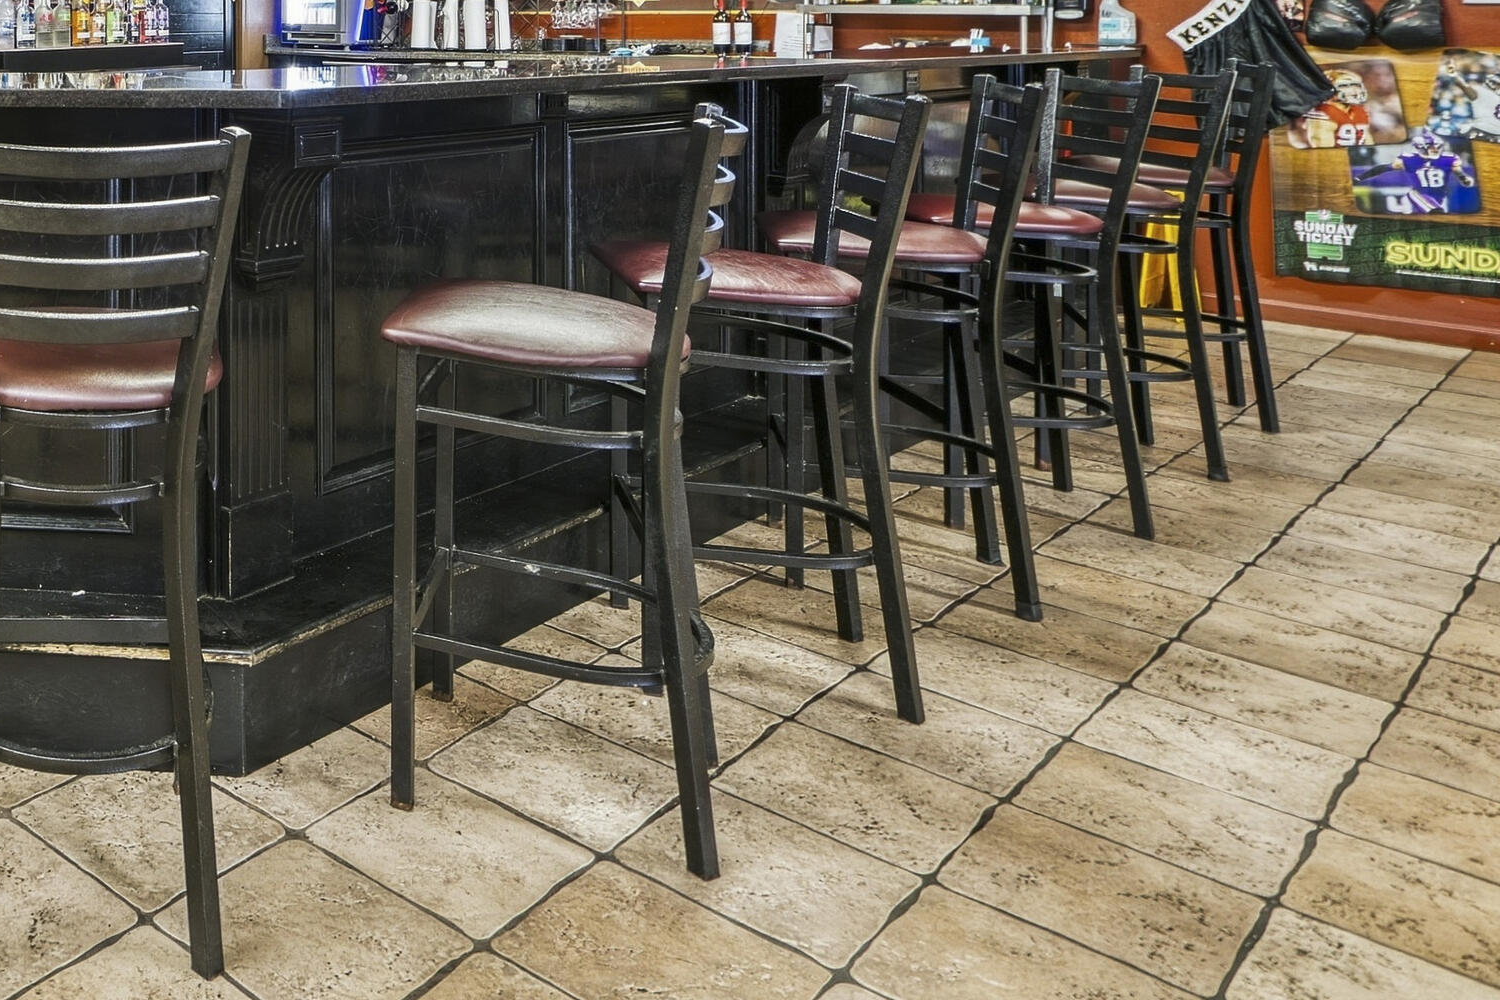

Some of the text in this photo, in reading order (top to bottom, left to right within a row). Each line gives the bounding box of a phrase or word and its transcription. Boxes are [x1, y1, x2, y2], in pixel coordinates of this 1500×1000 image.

[1415, 169, 1445, 188] 18
[1293, 220, 1359, 235] SUNDAY
[1297, 231, 1355, 246] TICKET
[1385, 240, 1500, 273] SUND
